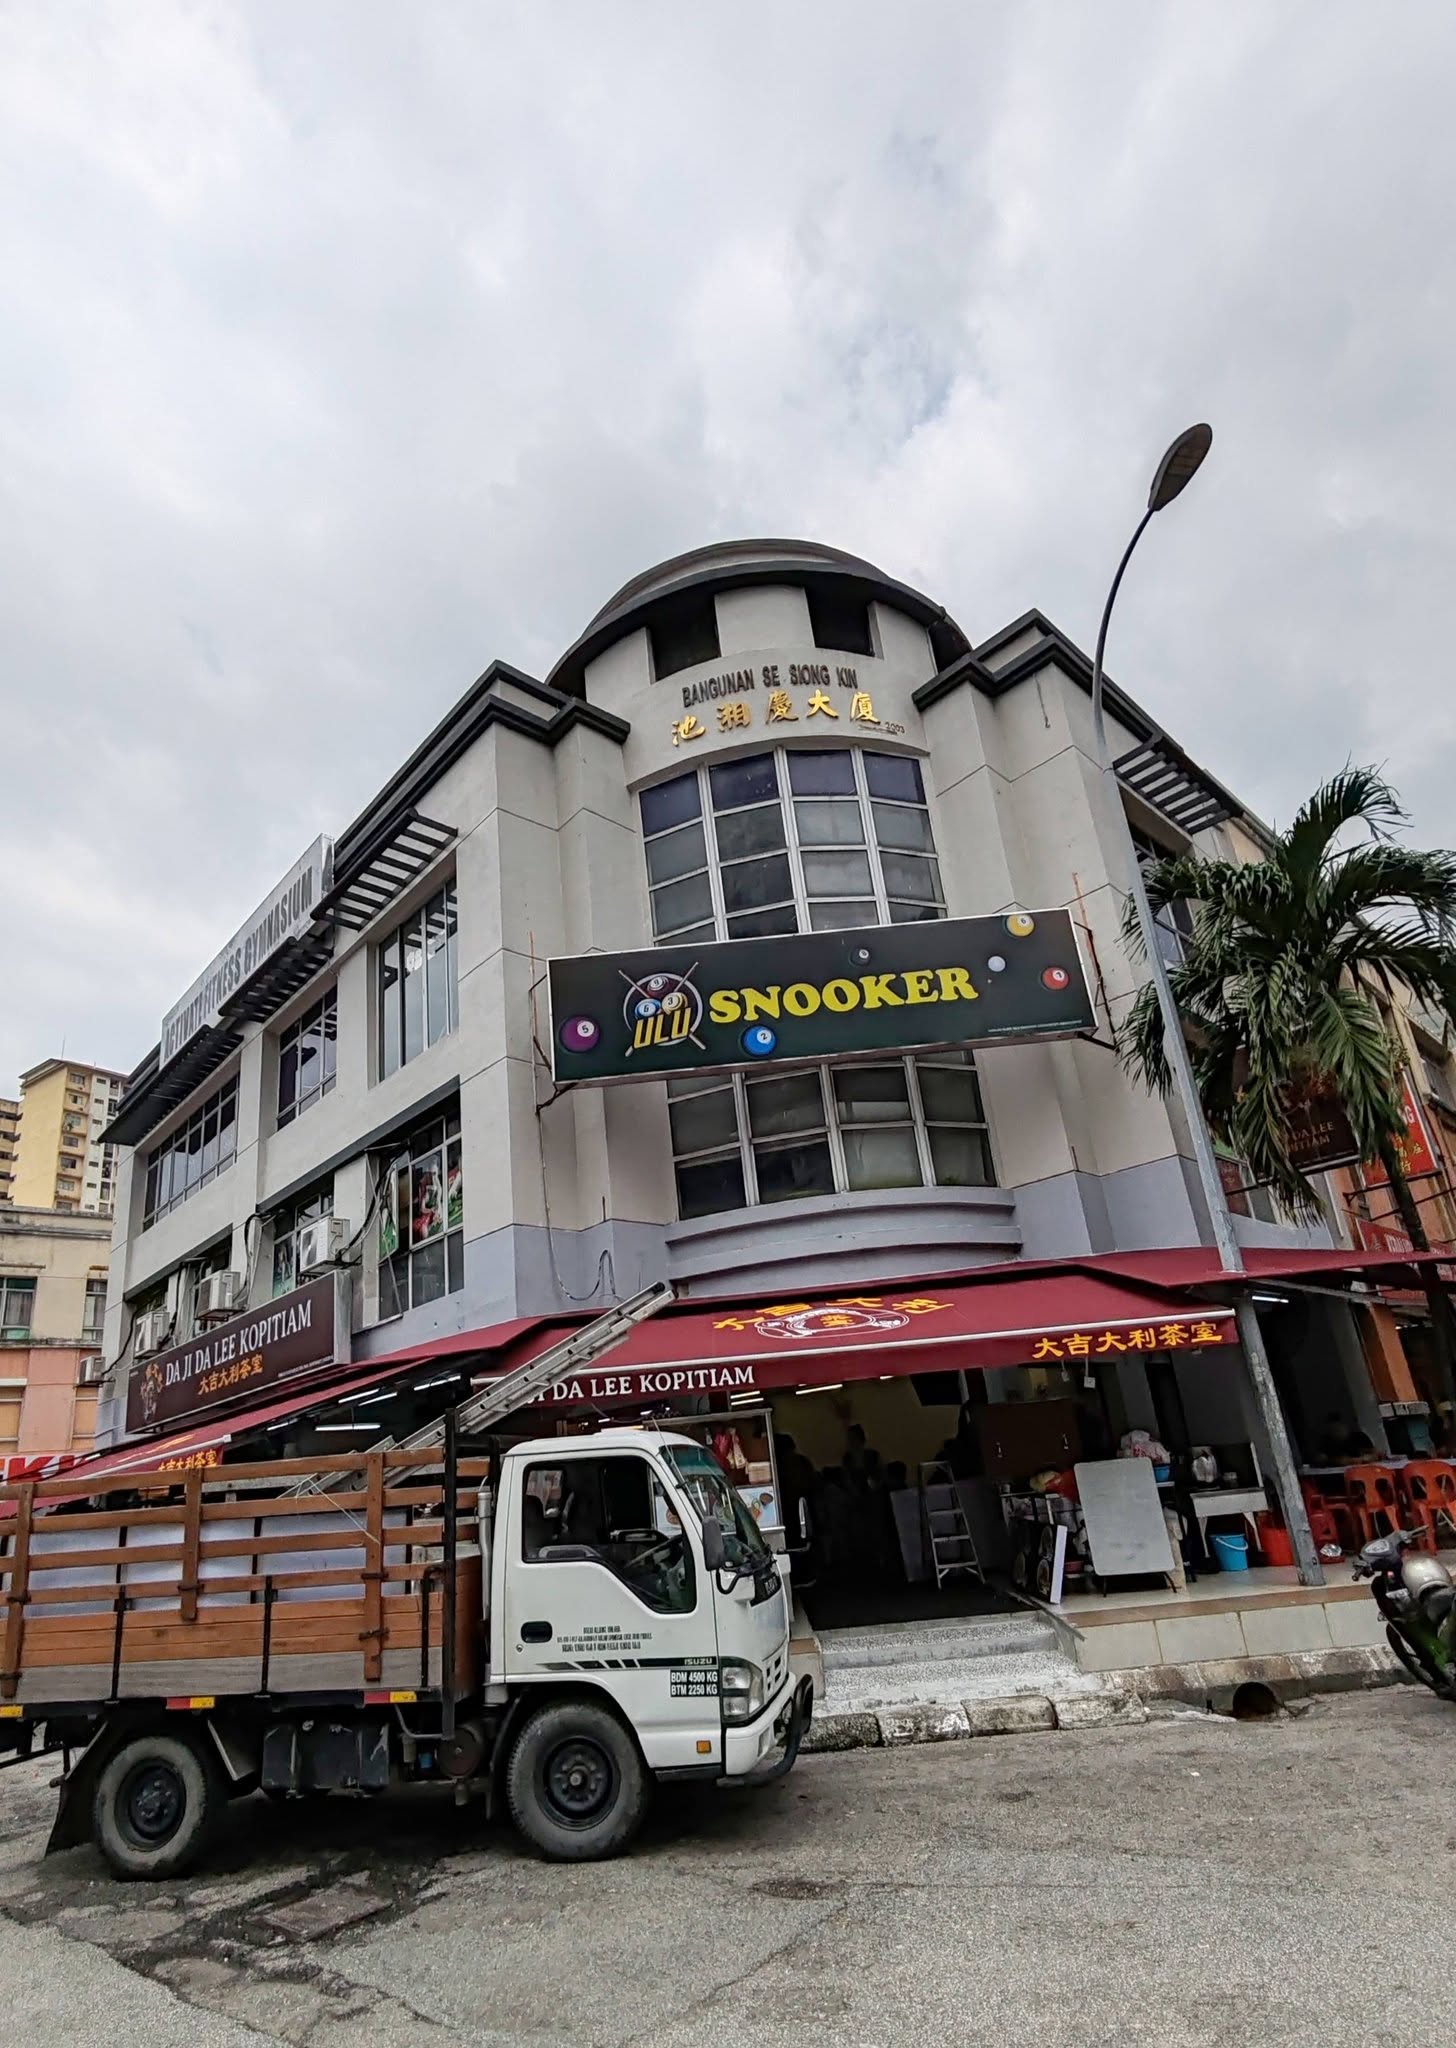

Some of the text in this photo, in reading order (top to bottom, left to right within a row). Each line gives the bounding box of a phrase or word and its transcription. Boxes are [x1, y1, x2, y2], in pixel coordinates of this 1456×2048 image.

[682, 664, 859, 708] BANGUNAN SE SIONG KIN
[203, 946, 242, 1020] FITNESS
[243, 865, 313, 976] GYMNASIUM
[708, 966, 979, 1024] SNOOKER
[633, 1007, 692, 1050] ULU
[165, 1363, 181, 1386] DA
[182, 1354, 193, 1381] JI
[195, 1344, 212, 1374] DA
[213, 1334, 237, 1367] LEE
[239, 1299, 312, 1356] KOPITIAM
[1032, 1320, 1223, 1360] 大吉大利茶室
[198, 1353, 264, 1396] 大吉大利茶室
[552, 1380, 585, 1401] DA
[590, 1375, 633, 1397] LEE
[639, 1365, 755, 1393] KOPITIAM
[671, 1671, 718, 1683] BDM 4500 KG
[684, 1657, 713, 1666] ISUZU
[671, 1683, 718, 1696] BTM 2250 KG
